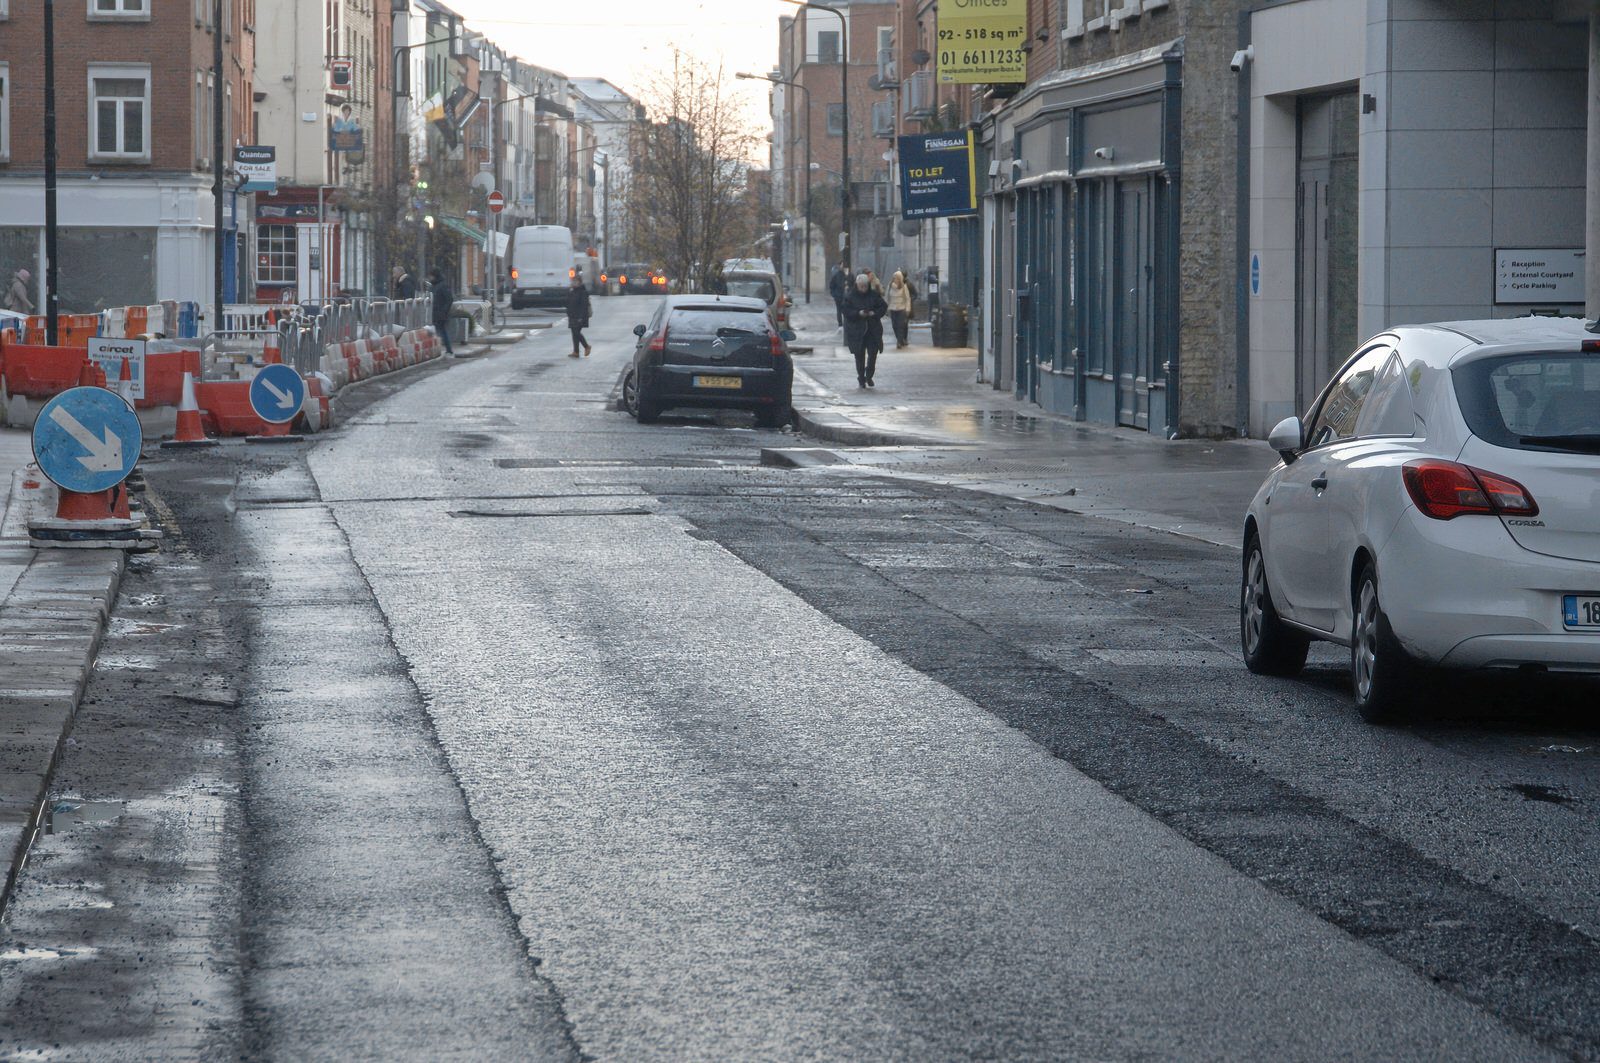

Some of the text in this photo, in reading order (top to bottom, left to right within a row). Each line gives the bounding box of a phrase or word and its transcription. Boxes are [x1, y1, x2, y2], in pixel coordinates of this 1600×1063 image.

[939, 30, 954, 40] 92
[965, 28, 987, 39] 518
[991, 30, 1004, 40] sq
[942, 49, 1022, 65] 01 6611233
[239, 150, 272, 158] Quantum
[909, 166, 944, 178] TO LET
[1511, 261, 1546, 269] Reception
[98, 344, 134, 354] circet
